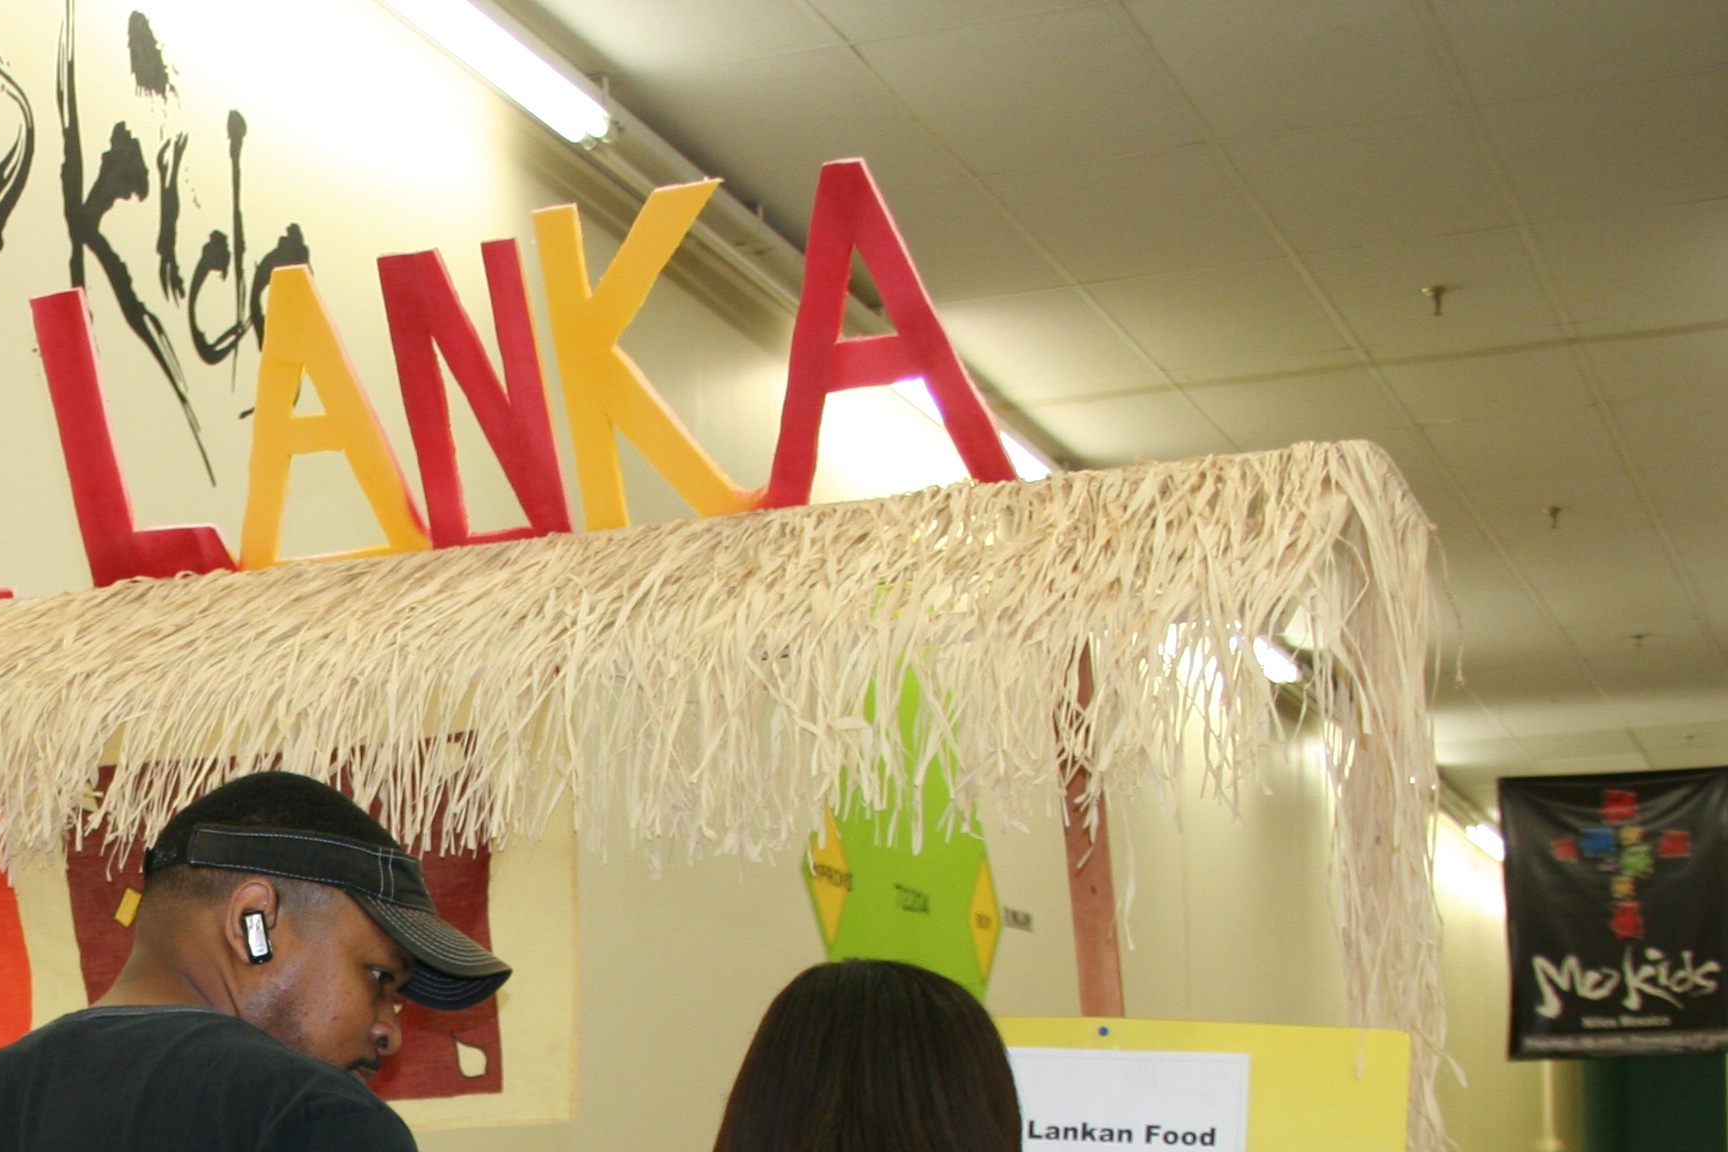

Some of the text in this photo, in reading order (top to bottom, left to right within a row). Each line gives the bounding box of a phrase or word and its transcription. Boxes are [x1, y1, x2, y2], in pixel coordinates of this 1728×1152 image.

[29, 157, 1018, 590] LANKA
[1027, 1120, 1216, 1147] Lankan Food
